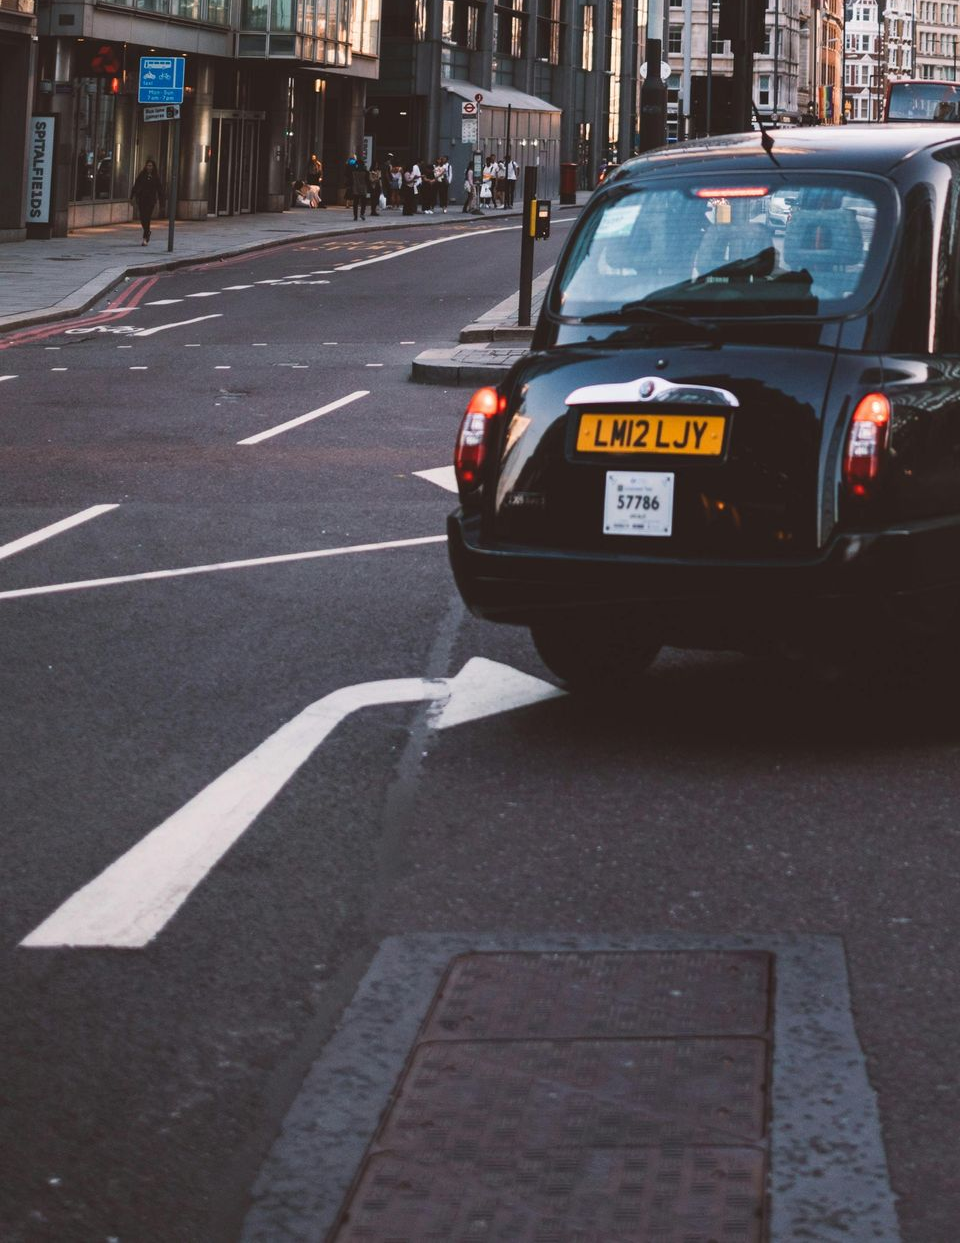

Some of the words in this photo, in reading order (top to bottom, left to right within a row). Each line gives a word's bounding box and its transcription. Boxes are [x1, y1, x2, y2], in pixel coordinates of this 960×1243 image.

[594, 419, 650, 447] LM12
[655, 420, 708, 449] LJY
[617, 495, 660, 511] 57786
